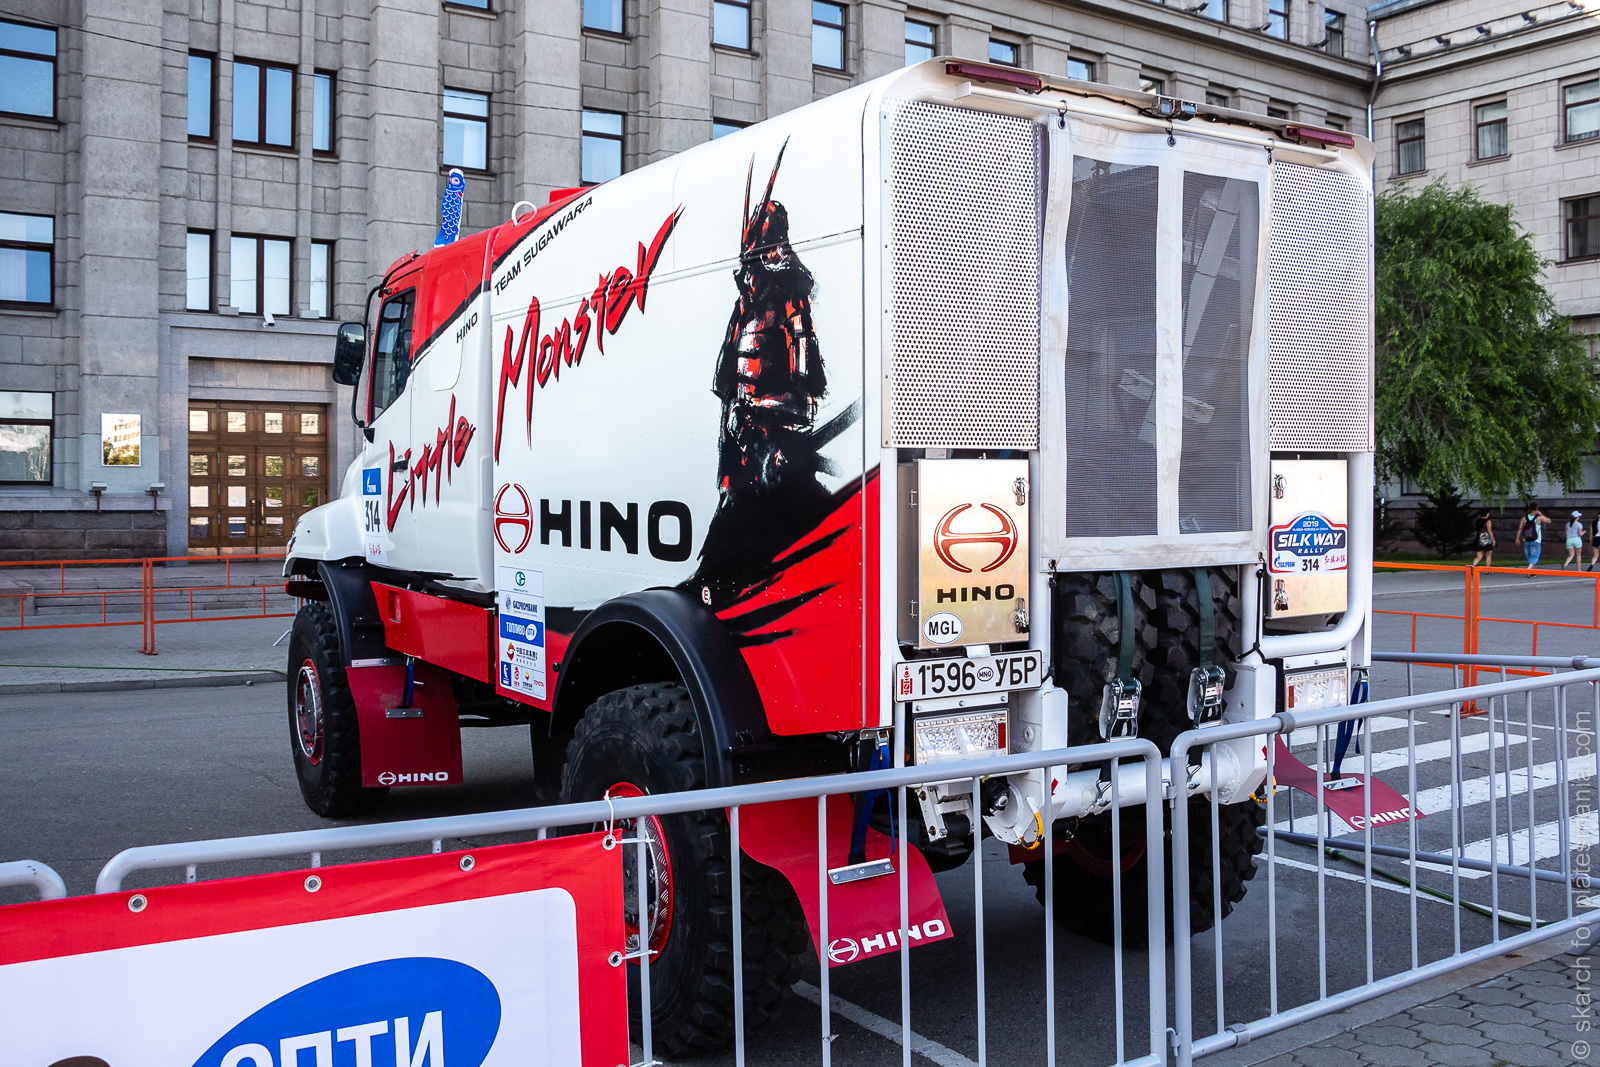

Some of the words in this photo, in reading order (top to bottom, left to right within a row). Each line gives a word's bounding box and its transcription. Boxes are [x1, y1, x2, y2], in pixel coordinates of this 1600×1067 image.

[494, 261, 523, 296] TEAM
[523, 196, 594, 267] SUGAWARA
[456, 311, 479, 344] HINO
[494, 202, 687, 465] Monster
[365, 500, 381, 533] 314
[540, 498, 693, 562] HINO
[1277, 533, 1313, 548] SILK
[1313, 532, 1343, 546] WAY
[1302, 559, 1319, 571] 314
[936, 584, 1015, 604] HINO
[928, 620, 959, 636] MGL
[918, 661, 976, 695] 1596
[995, 656, 1037, 687] УБР
[398, 772, 449, 783] HINO
[1370, 807, 1418, 824] HINO
[861, 919, 946, 953] HINO
